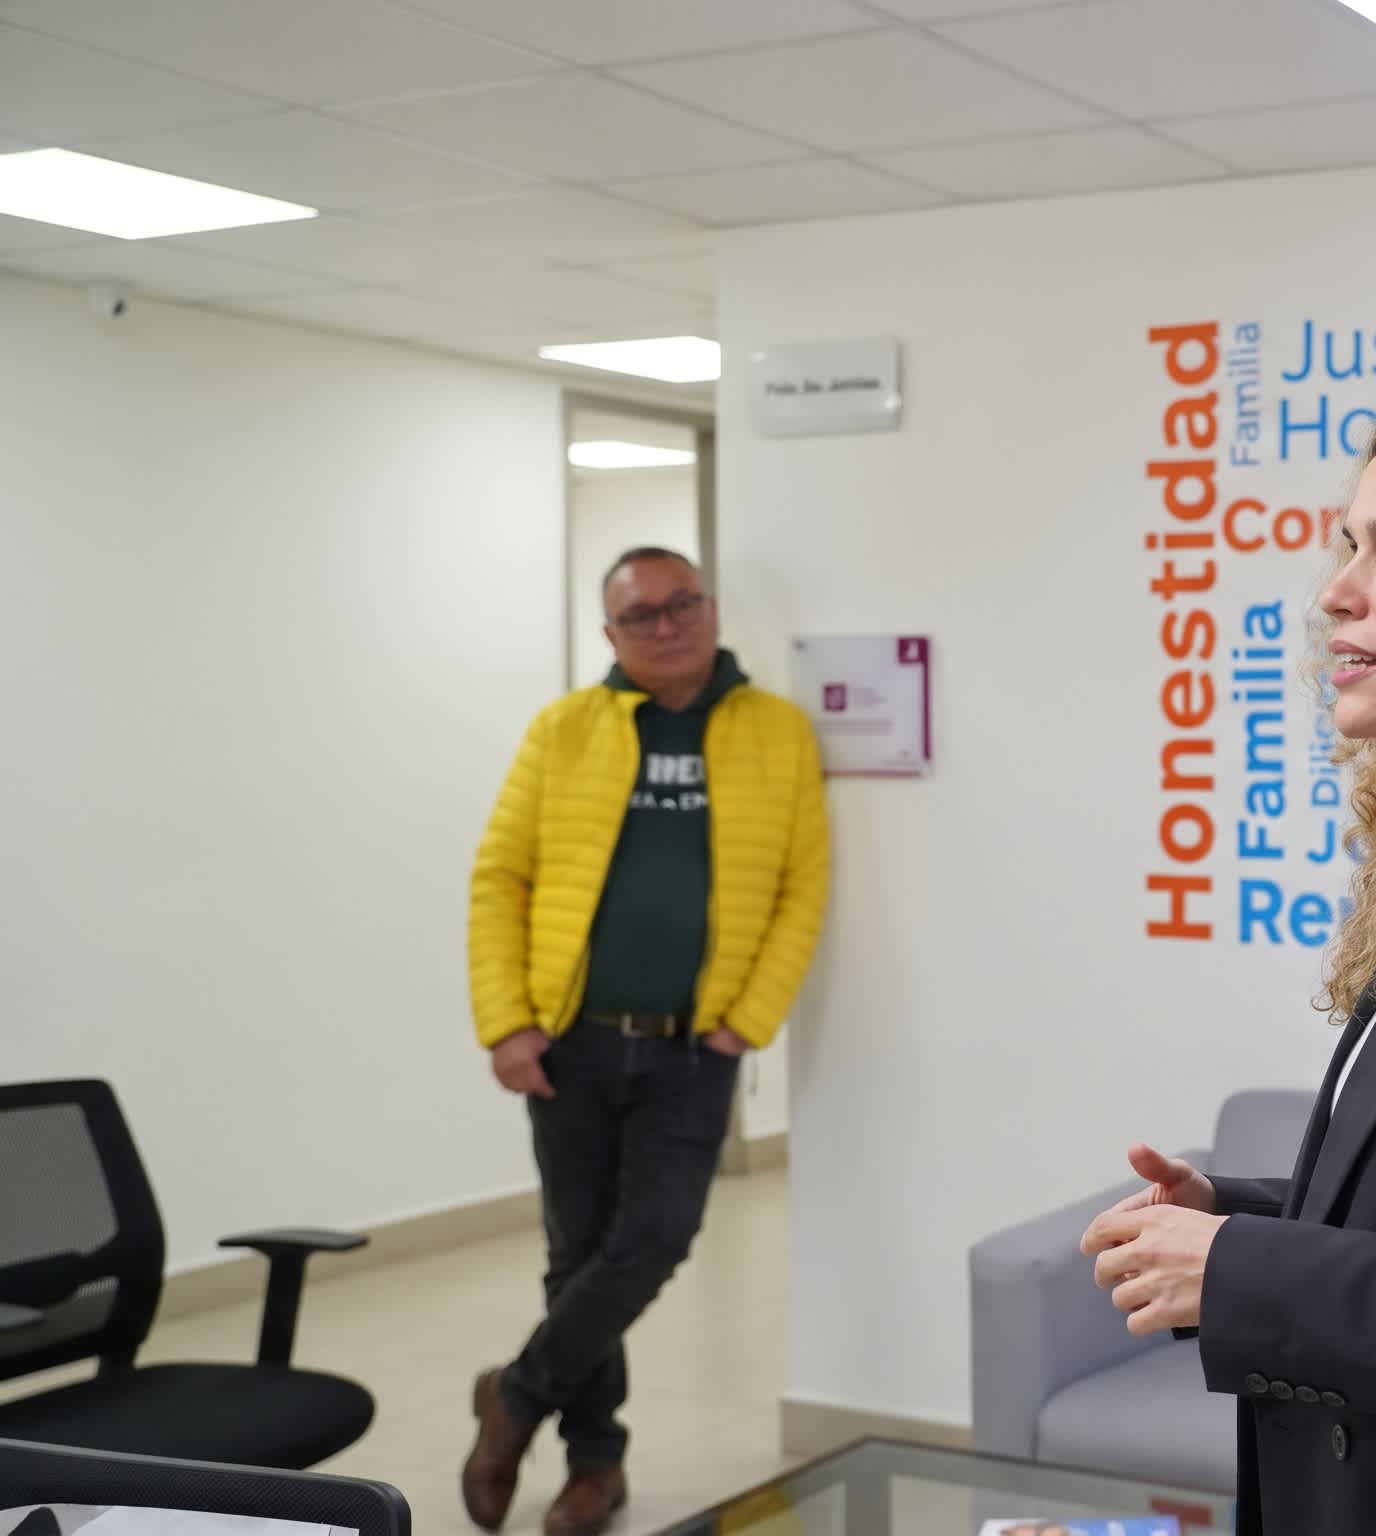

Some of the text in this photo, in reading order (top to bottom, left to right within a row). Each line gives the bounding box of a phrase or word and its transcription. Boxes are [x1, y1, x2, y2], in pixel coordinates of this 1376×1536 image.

[1229, 321, 1261, 466] Familia
[1145, 321, 1219, 940] Honestidad
[1233, 600, 1287, 860] Familia
